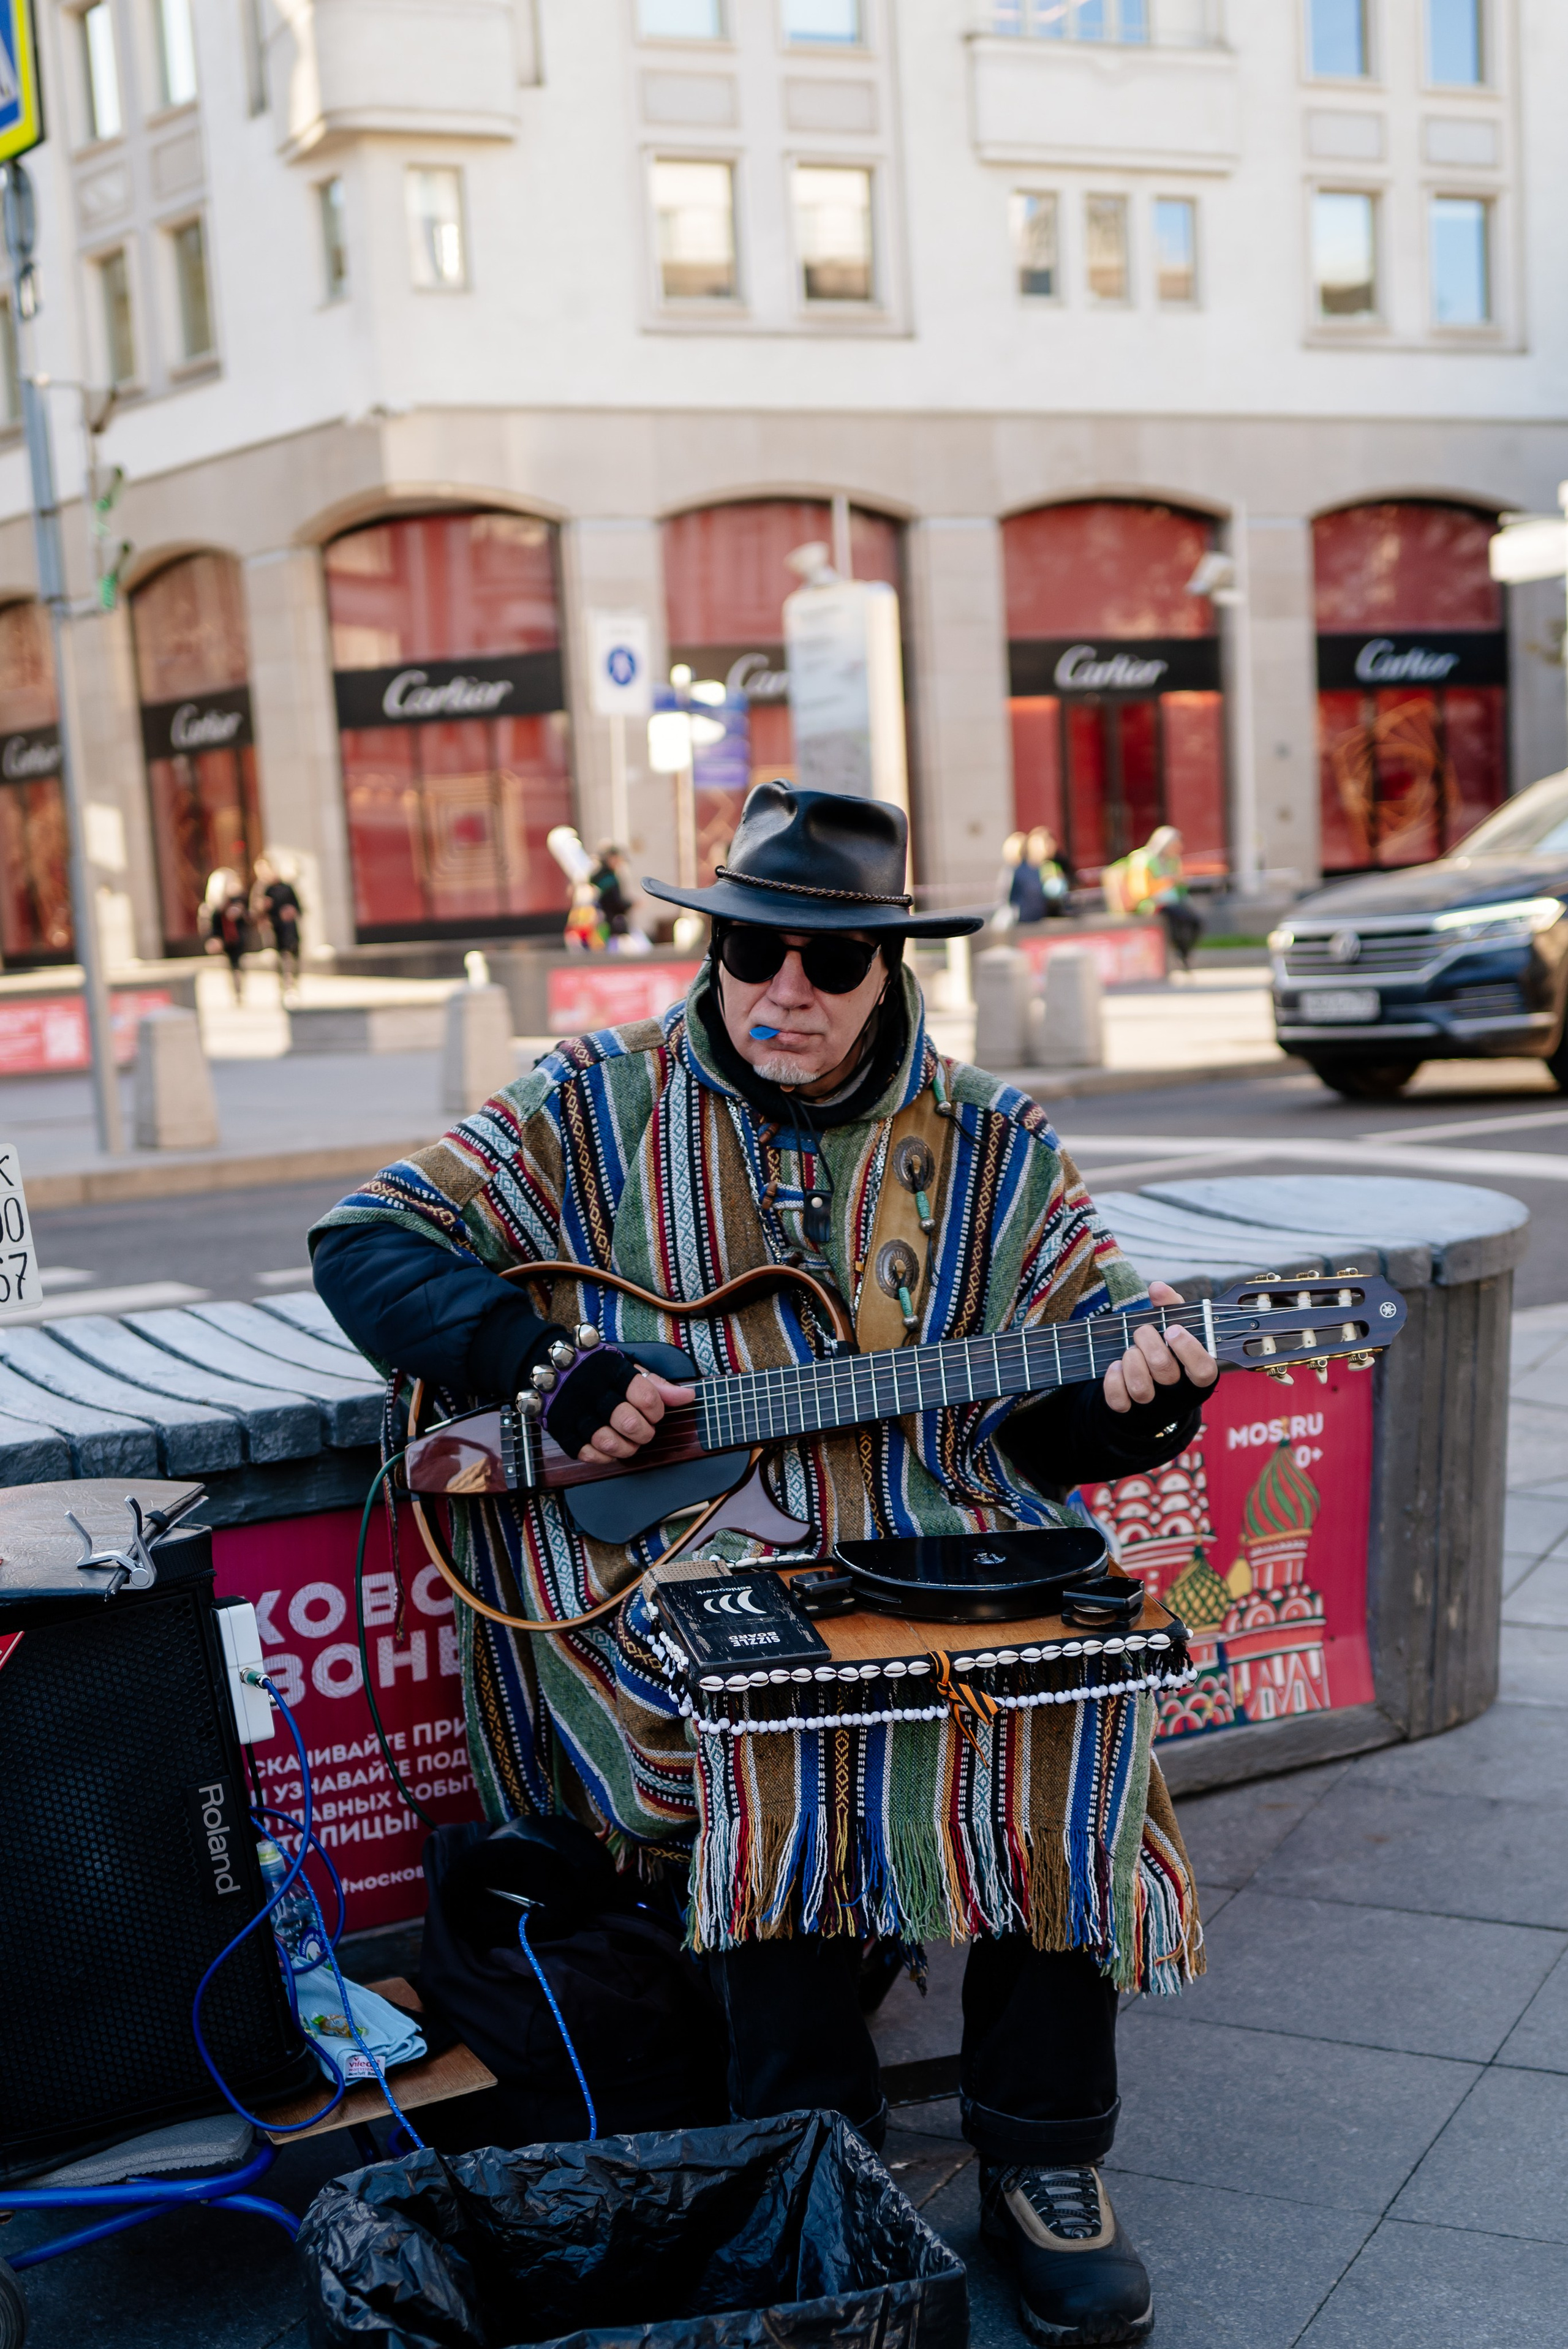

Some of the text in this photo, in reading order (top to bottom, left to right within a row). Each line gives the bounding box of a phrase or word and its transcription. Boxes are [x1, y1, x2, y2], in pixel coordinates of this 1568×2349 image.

[1054, 644, 1169, 691] Cartier
[1354, 638, 1461, 684] Cartier
[382, 669, 514, 719] Cartier
[1227, 1411, 1324, 1450] MOS.RU
[1295, 1444, 1324, 1469] 0+
[696, 1585, 752, 1595] schlagwerk
[728, 1631, 777, 1641] BOARD
[733, 1635, 781, 1647] SIZZLE
[417, 1748, 468, 1774] ПОД
[198, 1783, 241, 1895] Roland
[276, 1811, 418, 1854] ТОЛИЦЫ!
